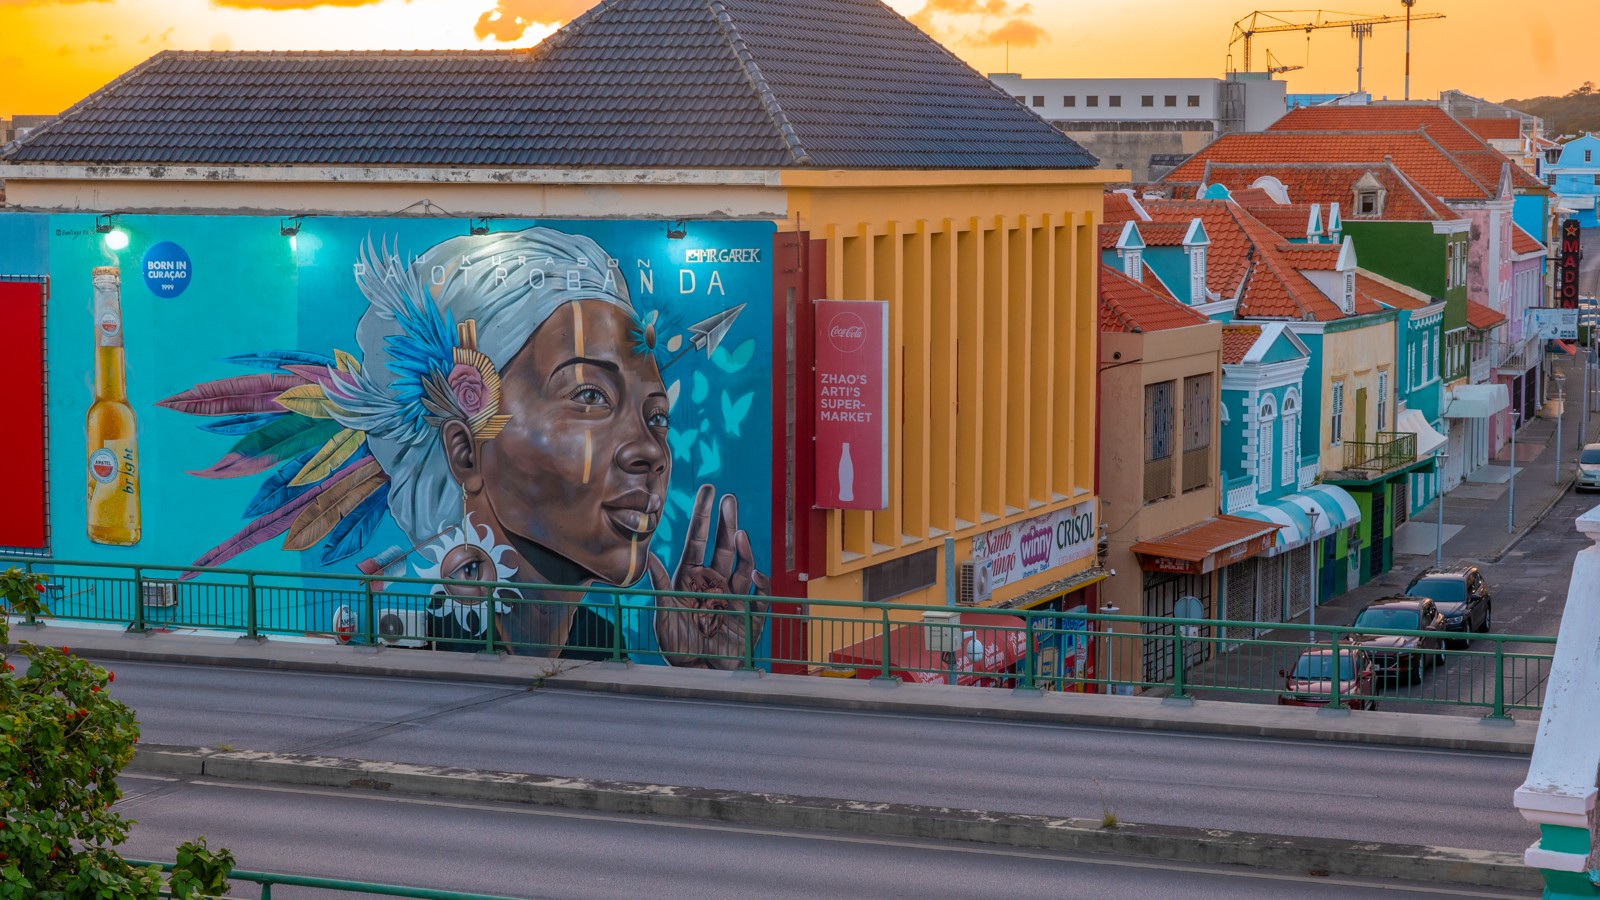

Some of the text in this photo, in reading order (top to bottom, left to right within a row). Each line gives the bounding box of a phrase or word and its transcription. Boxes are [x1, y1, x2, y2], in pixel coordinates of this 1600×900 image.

[147, 261, 187, 270] BORN IN
[147, 270, 187, 281] CURAÇAO
[820, 373, 868, 385] ZHAO'S
[820, 386, 861, 397] ARTI'S
[820, 398, 866, 409] SUPER-
[820, 411, 873, 423] MARKET
[122, 448, 134, 495] bright
[1056, 511, 1095, 550] CRISOL
[983, 526, 1012, 558] Santo
[1021, 531, 1052, 563] winny
